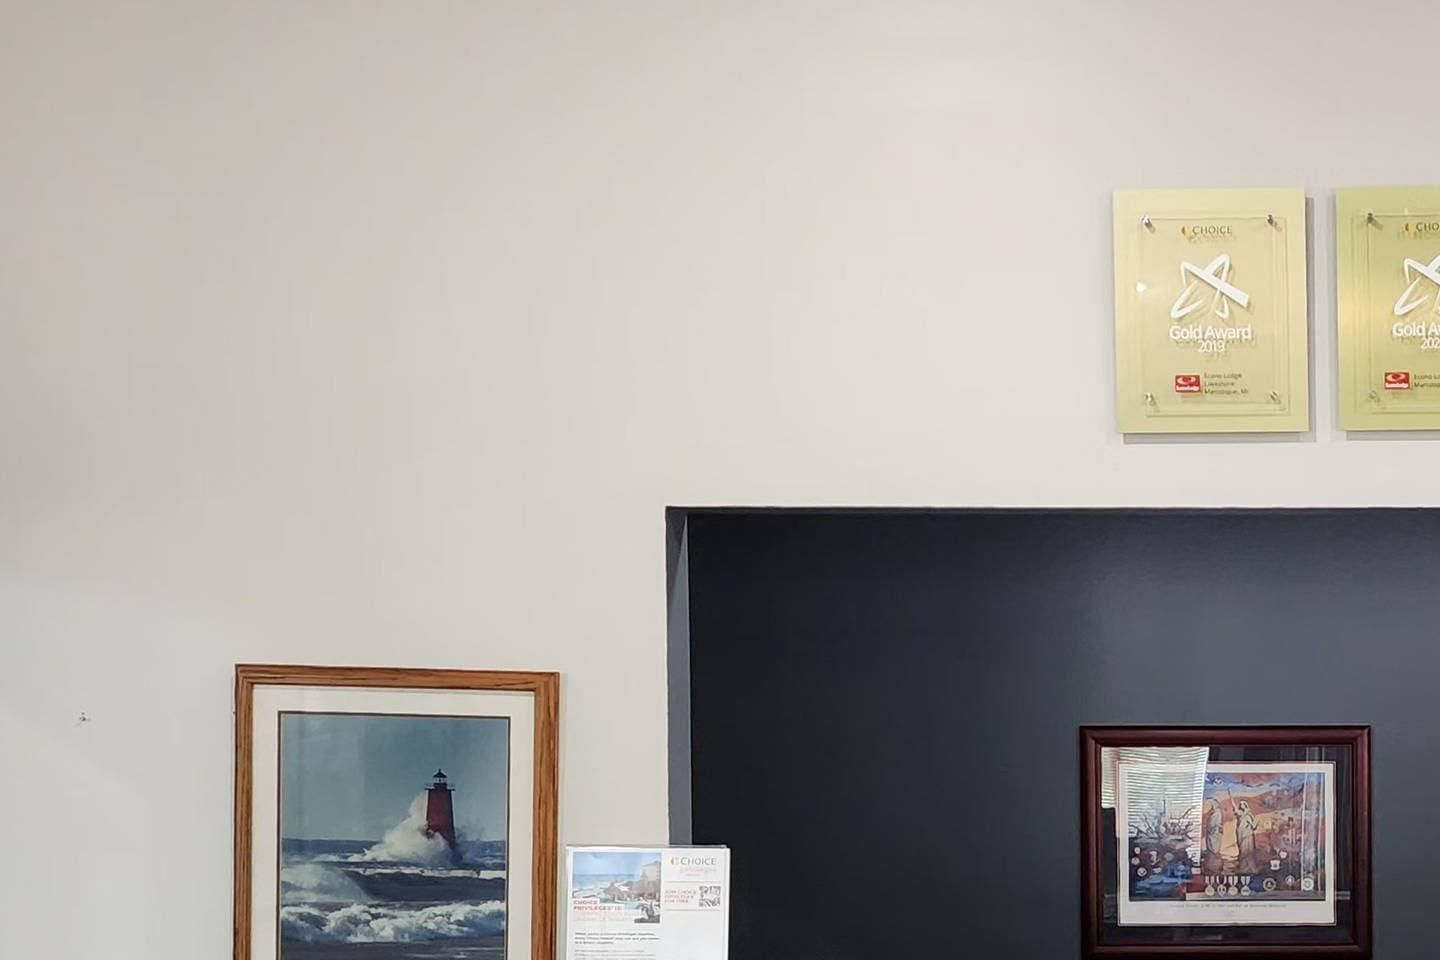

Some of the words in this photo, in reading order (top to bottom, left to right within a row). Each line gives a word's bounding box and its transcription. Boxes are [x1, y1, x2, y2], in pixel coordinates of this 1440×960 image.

[1192, 225, 1233, 235] CHOICE
[1169, 324, 1202, 340] Gold
[1204, 323, 1252, 340] Award
[1392, 321, 1425, 337] Gold
[1198, 340, 1226, 352] 2019
[680, 856, 717, 866] CHOICE
